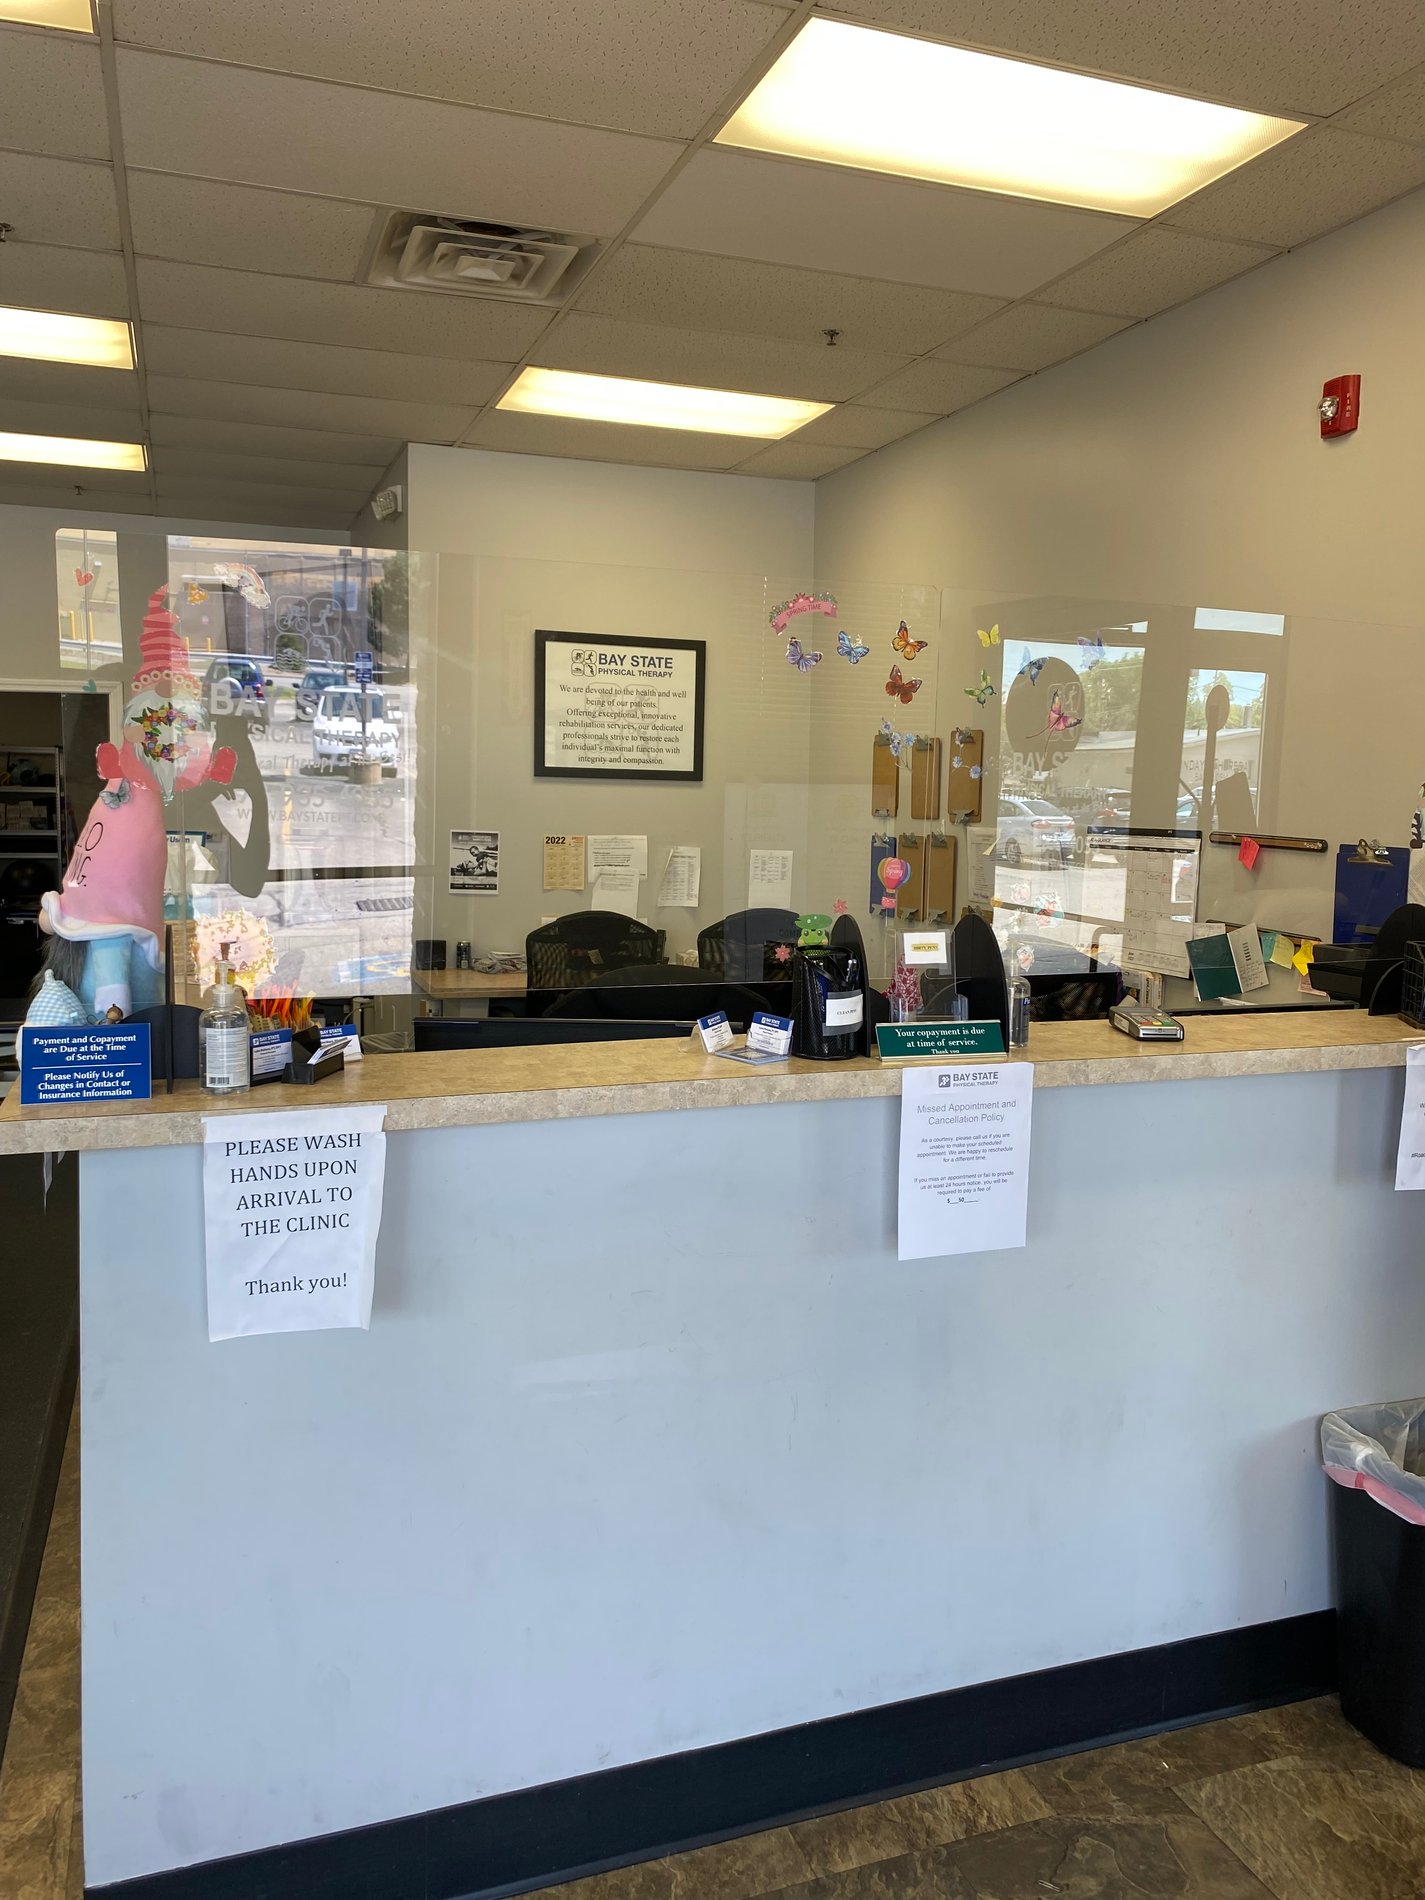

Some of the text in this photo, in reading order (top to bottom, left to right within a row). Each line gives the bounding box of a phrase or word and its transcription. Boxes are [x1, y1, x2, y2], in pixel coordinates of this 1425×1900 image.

[786, 606, 807, 618] SPRING
[599, 654, 672, 669] BAY STATE
[598, 668, 672, 678] PHYSICAL THERAPY
[586, 686, 612, 694] devoted
[636, 688, 656, 696] health
[211, 683, 401, 724] BAY STATE
[586, 698, 605, 707] being
[630, 701, 656, 709] patients.
[567, 709, 676, 720] Offering exceptional, innovative
[559, 720, 605, 728] rehabilitation
[651, 724, 683, 732] dedicated
[563, 732, 608, 741] professionals
[636, 745, 663, 753] function
[578, 755, 606, 763] integrity
[545, 836, 566, 845] 2022
[895, 1029, 914, 1037] Your
[917, 1029, 960, 1038] copayment
[34, 1037, 69, 1046] Payment
[90, 1035, 136, 1044] Copayment
[74, 1071, 100, 1081] Notify
[953, 1072, 998, 1081] BAY STATE
[38, 1082, 73, 1091] Changes
[40, 1088, 132, 1099] Insurance Information
[917, 1104, 946, 1113] Missed
[949, 1101, 999, 1112] Appointment
[928, 1113, 1005, 1125] Cancellation Policy
[225, 1133, 361, 1156] PLEASE WASH
[230, 1160, 357, 1183] HANDS UPON
[236, 1187, 352, 1210] ARRIVAL TO
[241, 1213, 350, 1237] THE CLINIC
[245, 1273, 347, 1295] Thank you!
